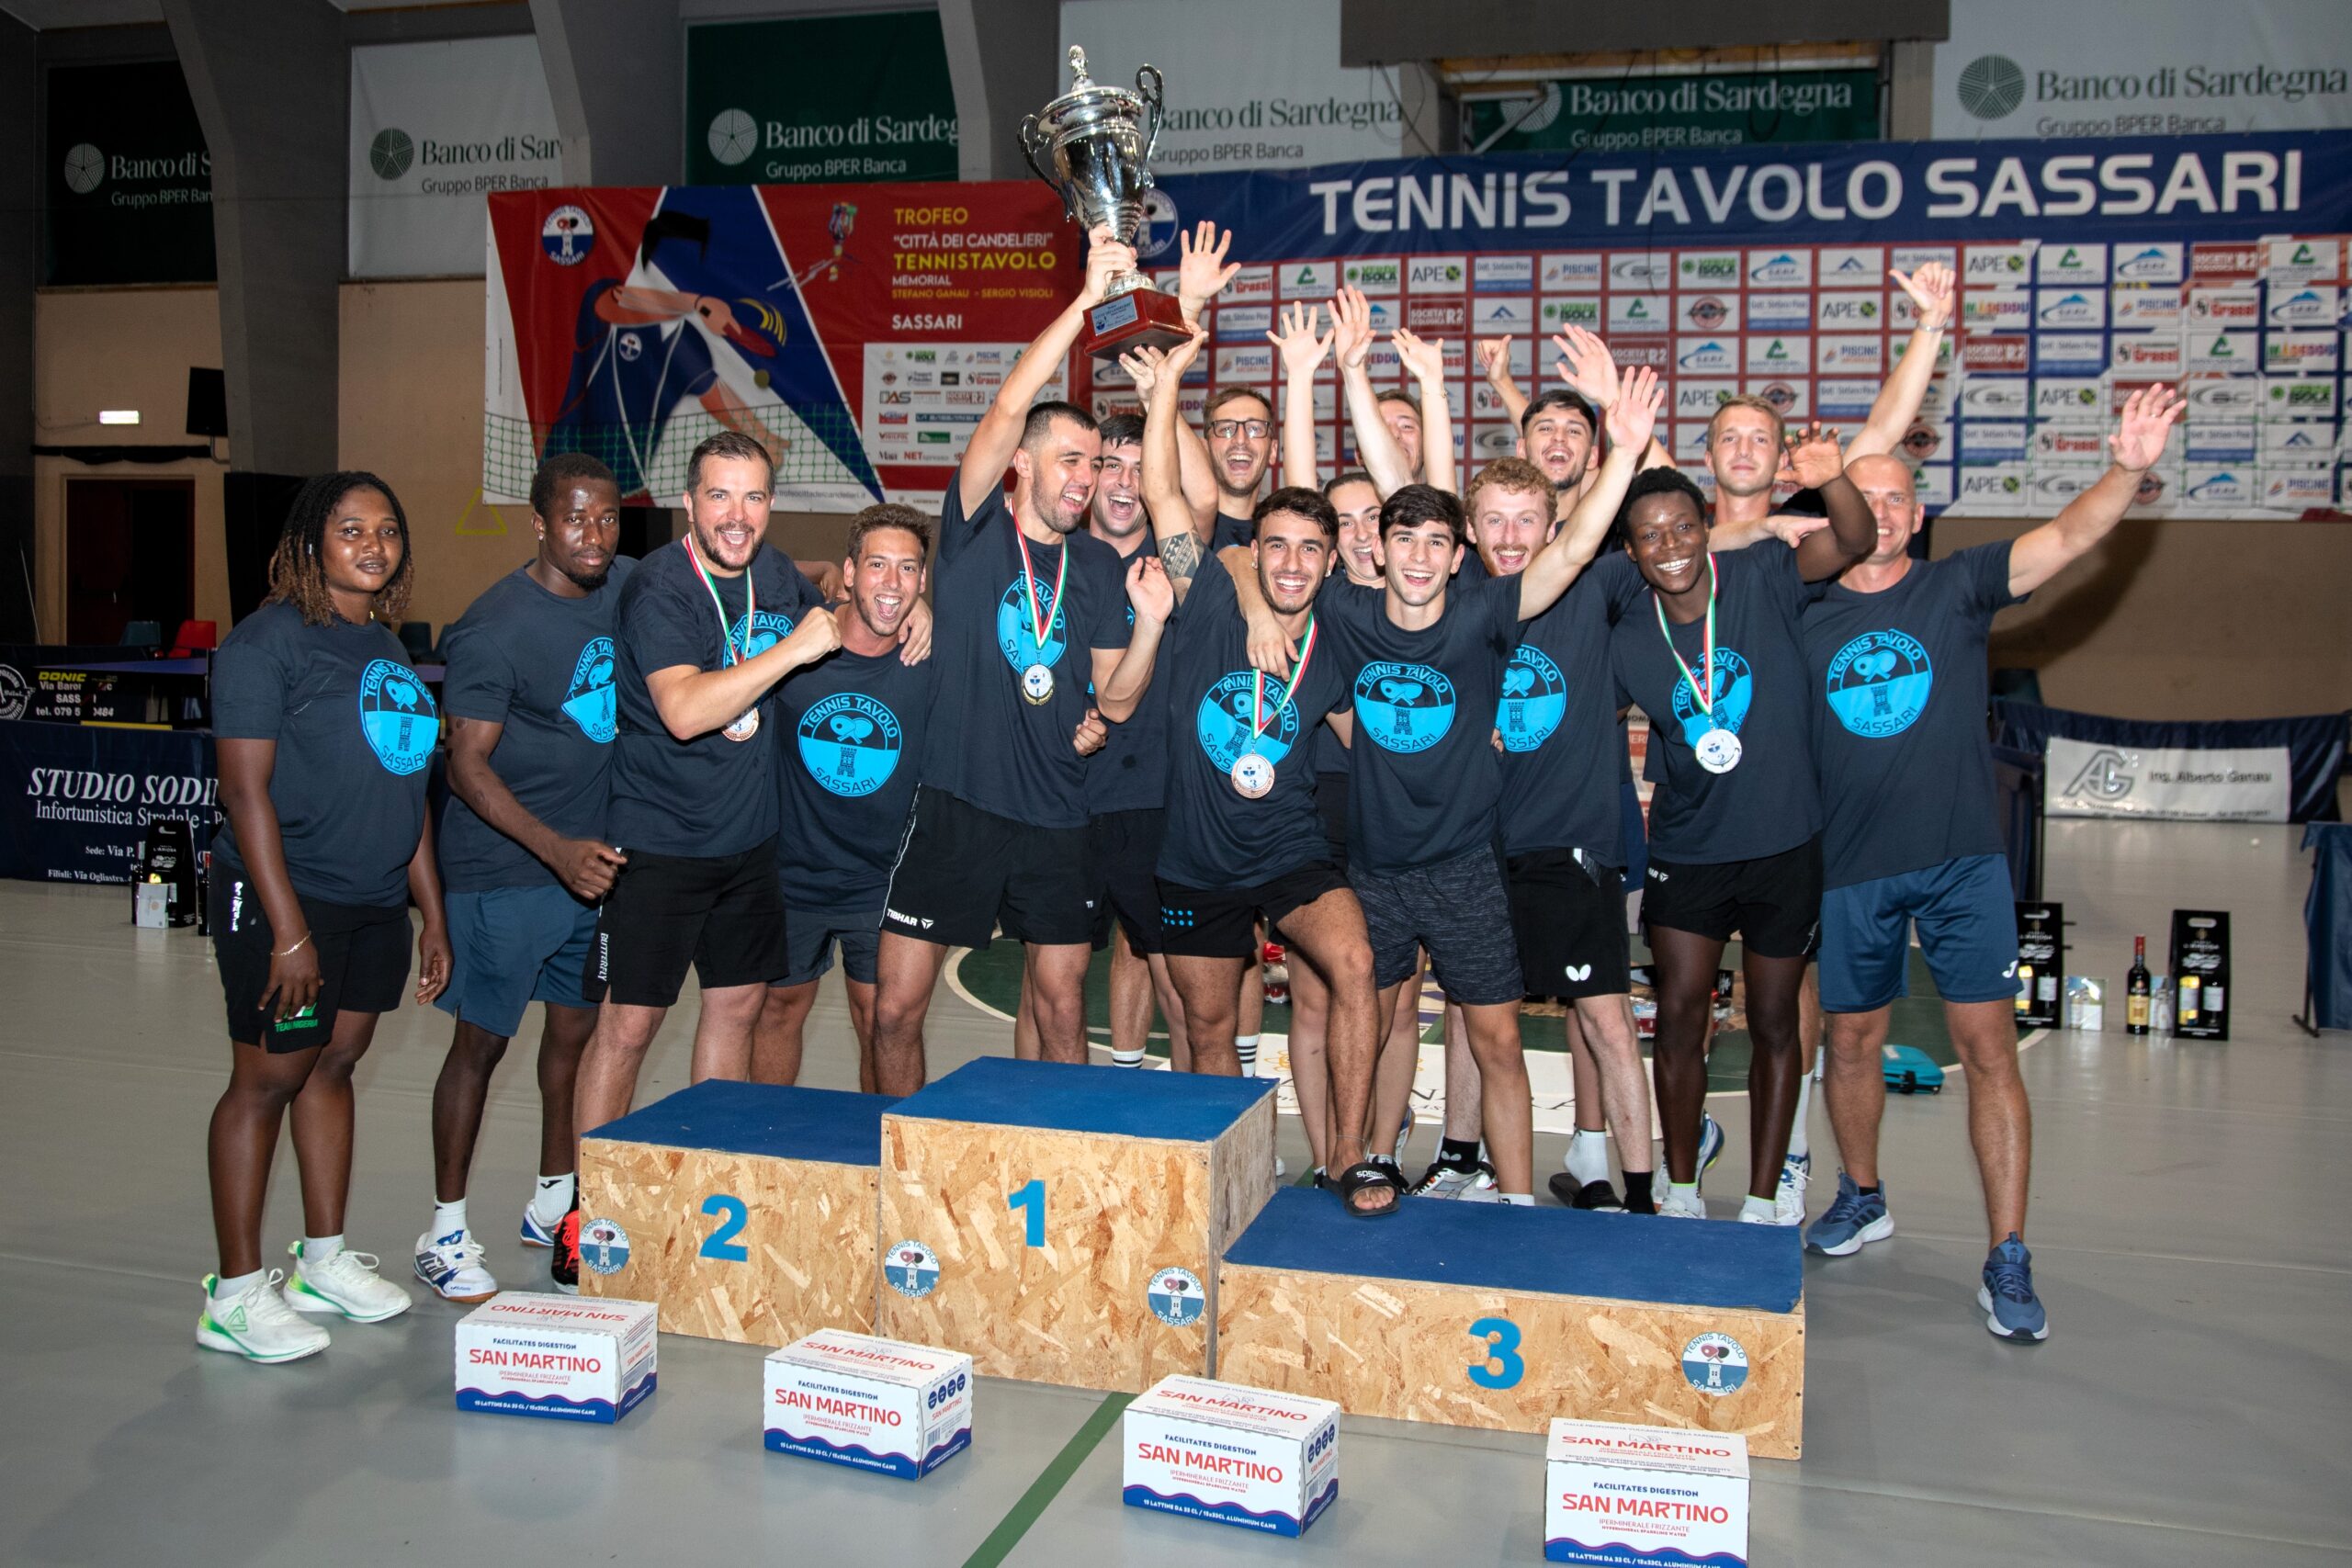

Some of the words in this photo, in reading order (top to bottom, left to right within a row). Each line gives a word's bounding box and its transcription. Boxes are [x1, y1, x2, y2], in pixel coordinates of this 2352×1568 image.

[2036, 70, 2141, 102] Banco
[2147, 67, 2176, 98] di
[2184, 64, 2346, 103] Sardegna
[1570, 84, 1667, 116] Banco
[1669, 81, 1697, 114] di
[1704, 79, 1852, 117] Sardegna
[1239, 100, 1262, 128] di
[1270, 97, 1403, 130] Sardegna
[764, 120, 843, 149] Banco
[848, 117, 870, 145] di
[875, 113, 958, 145] Sardeg
[2036, 117, 2111, 138] Gruppo
[2115, 115, 2160, 134] BPER
[2167, 114, 2225, 133] Banca
[422, 139, 492, 165] Banco
[496, 136, 515, 162] di
[520, 134, 563, 161] Sar
[1570, 129, 1639, 152] Gruppo
[1641, 128, 1687, 148] BPER
[1689, 126, 1743, 145] Banca
[1149, 144, 1210, 165] Gruppo
[1213, 143, 1252, 161] BPER
[1256, 141, 1304, 159] Banca
[111, 154, 175, 179] Banco
[178, 152, 197, 176] di
[765, 161, 821, 181] Gruppo
[824, 158, 861, 175] BPER
[863, 157, 907, 175] Banca
[422, 176, 472, 197] Gruppo
[474, 175, 507, 193] BPER
[510, 174, 549, 190] Banca
[1310, 170, 1571, 235] TENNIS
[1591, 160, 1904, 226] TAVOLO
[1925, 149, 2301, 220] SASSARI
[111, 190, 158, 209] Gruppo
[160, 188, 189, 203] BPER
[894, 208, 968, 225] TROFEO
[942, 233, 964, 248] DEI
[894, 251, 1057, 270] TENNISTAVOLO
[1968, 255, 2005, 273] APE
[892, 275, 952, 286] MEMORIAL
[1412, 265, 1444, 282] APE
[891, 288, 934, 299] STEFANO
[935, 288, 969, 299] GANAU
[981, 288, 1016, 299] SERGIO
[1019, 288, 1054, 299] VISIOLI
[1447, 310, 1464, 324] R2
[1823, 301, 1859, 319] APE
[891, 314, 962, 331] SASSARI
[1236, 355, 1270, 367] PISCINE
[1679, 390, 1714, 407] APE
[2040, 388, 2075, 405] APE
[1963, 476, 2001, 493] APE
[1515, 648, 1558, 682] TAVOLO
[1830, 637, 1872, 680] TENNIS
[1875, 632, 1922, 660] TAVOLO
[39, 671, 87, 682] DONIC
[570, 644, 597, 692] TENNIS
[1359, 664, 1401, 688] TENNIS
[1406, 665, 1449, 694] TAVOLO
[40, 681, 54, 691] Via
[36, 706, 51, 716] tel.
[54, 706, 73, 716] 079
[803, 696, 851, 729] TENNIS
[854, 697, 899, 739] TAVOLO
[1852, 705, 1918, 734] SASSARI
[1372, 727, 1439, 750] SASSARI
[380, 745, 427, 770] SASSARI
[27, 767, 135, 803] STUDIO
[814, 766, 877, 794] SASSARI
[2176, 770, 2223, 783] Alberto
[2227, 770, 2273, 783] Ganau
[36, 799, 133, 826] Infortunistica
[137, 806, 199, 829] Stradale
[85, 845, 106, 856] Sede:
[107, 845, 124, 857] Via
[127, 845, 135, 857] P.
[48, 869, 73, 879] Filiali:
[74, 870, 88, 880] Via
[887, 908, 918, 927] TIBHAR
[597, 932, 609, 982] BUTTERFLY
[1008, 1179, 1046, 1247] 1
[582, 1219, 604, 1238] TENNIS
[605, 1219, 628, 1242] TAVOLO
[699, 1193, 749, 1262] 2
[886, 1241, 910, 1260] TENNIS
[912, 1241, 938, 1266] TAVOLO
[586, 1258, 623, 1275] SASSARI
[892, 1281, 931, 1298] SASSARI
[1150, 1268, 1175, 1288] TENNIS
[1178, 1268, 1204, 1292] TAVOLO
[490, 1304, 584, 1320] MARTINO
[584, 1311, 629, 1322] SAN
[1156, 1310, 1195, 1327] SASSARI
[492, 1337, 537, 1348] FACILITATES
[537, 1341, 577, 1350] DIGESTION
[1467, 1317, 1525, 1390] 3
[1684, 1333, 1713, 1355] TENNIS
[1716, 1333, 1747, 1359] TAVOLO
[469, 1348, 508, 1366] SAN
[513, 1352, 601, 1373] MARTINO
[801, 1341, 844, 1354] SAN
[845, 1349, 935, 1371] MARTINO
[797, 1380, 840, 1394] FACILITATES
[841, 1388, 878, 1401] DIGESTION
[775, 1388, 812, 1408] SAN
[816, 1396, 901, 1427] MARTINO
[1157, 1390, 1204, 1403] SAN
[1204, 1398, 1308, 1421] MARTINO
[1165, 1434, 1213, 1449] FACILITATES
[1214, 1443, 1257, 1456] DIGESTION
[1561, 1436, 1611, 1447] SAN
[1618, 1440, 1732, 1458] MARTINO
[1138, 1442, 1180, 1465] SAN
[1185, 1450, 1283, 1483] MARTINO
[1170, 1469, 1215, 1483] IPERMINERALE
[1215, 1476, 1250, 1489] FRIZZANTE
[1593, 1482, 1648, 1494] FACILITATES
[1649, 1487, 1699, 1497] DIGESTION
[1563, 1493, 1611, 1513] SAN
[1617, 1497, 1729, 1524] MARTINO
[1227, 1515, 1260, 1527] ALUMINIUM
[1261, 1521, 1277, 1530] CANS
[1599, 1518, 1650, 1530] IPERMINERALE
[1651, 1522, 1690, 1533] FRIZZANTE
